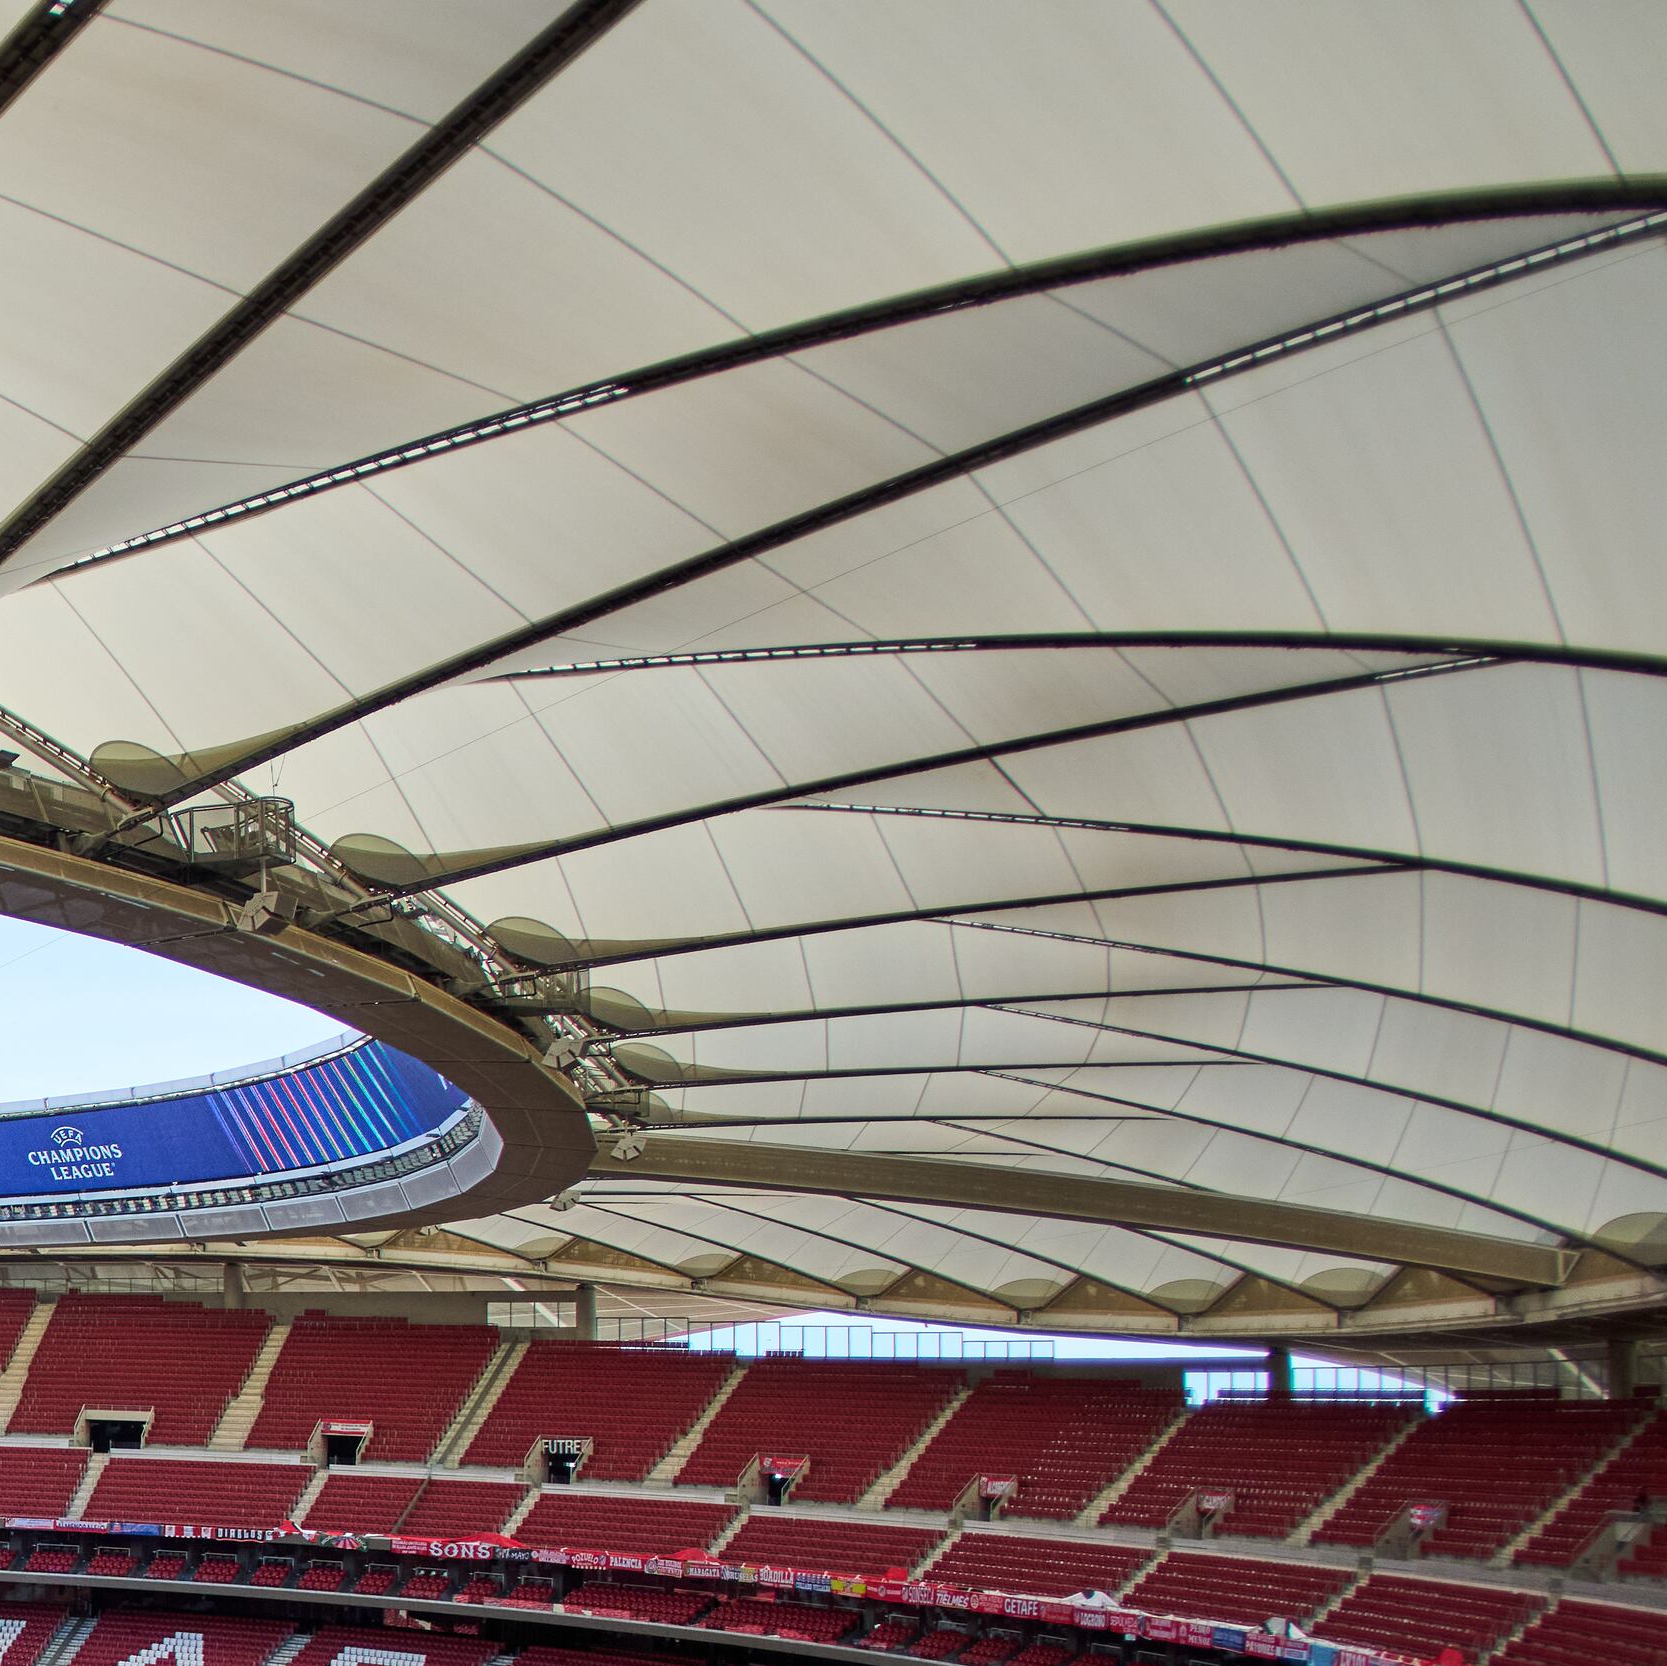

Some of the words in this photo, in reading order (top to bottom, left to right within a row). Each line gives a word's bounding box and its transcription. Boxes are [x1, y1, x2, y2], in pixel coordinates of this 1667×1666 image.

[54, 1130, 82, 1145] UEFA
[28, 1144, 122, 1165] CHAMPIONS
[50, 1163, 114, 1181] LEAGUE
[542, 1439, 581, 1454] FUTRE
[430, 1542, 492, 1558] SONS
[609, 1557, 642, 1568] PALENCIA
[936, 1592, 970, 1607] TIELMES
[1004, 1598, 1039, 1616] GETAFE
